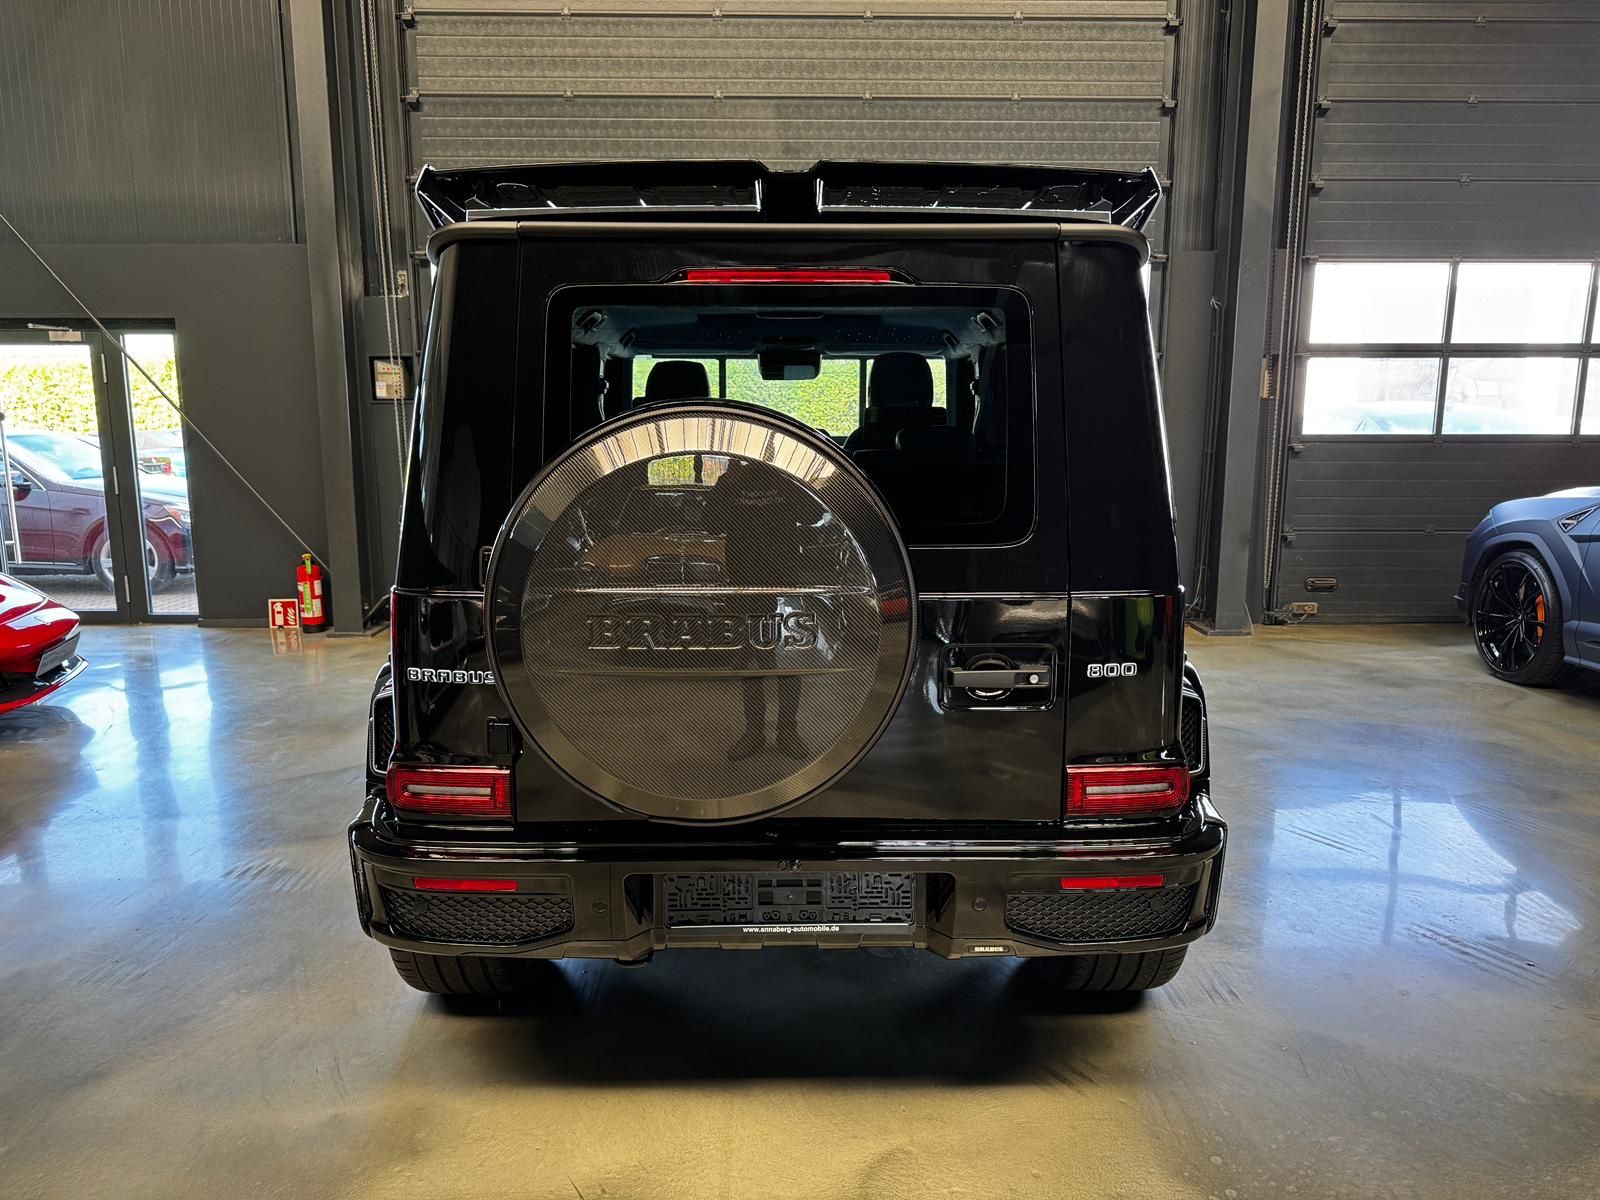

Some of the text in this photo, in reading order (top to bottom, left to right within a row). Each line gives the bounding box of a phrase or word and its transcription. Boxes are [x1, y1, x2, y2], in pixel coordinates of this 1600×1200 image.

[585, 612, 817, 650] BRABUS
[407, 667, 496, 684] BRABUS
[1086, 662, 1138, 678] 800
[742, 925, 840, 934] www.annaberg-automobile.de
